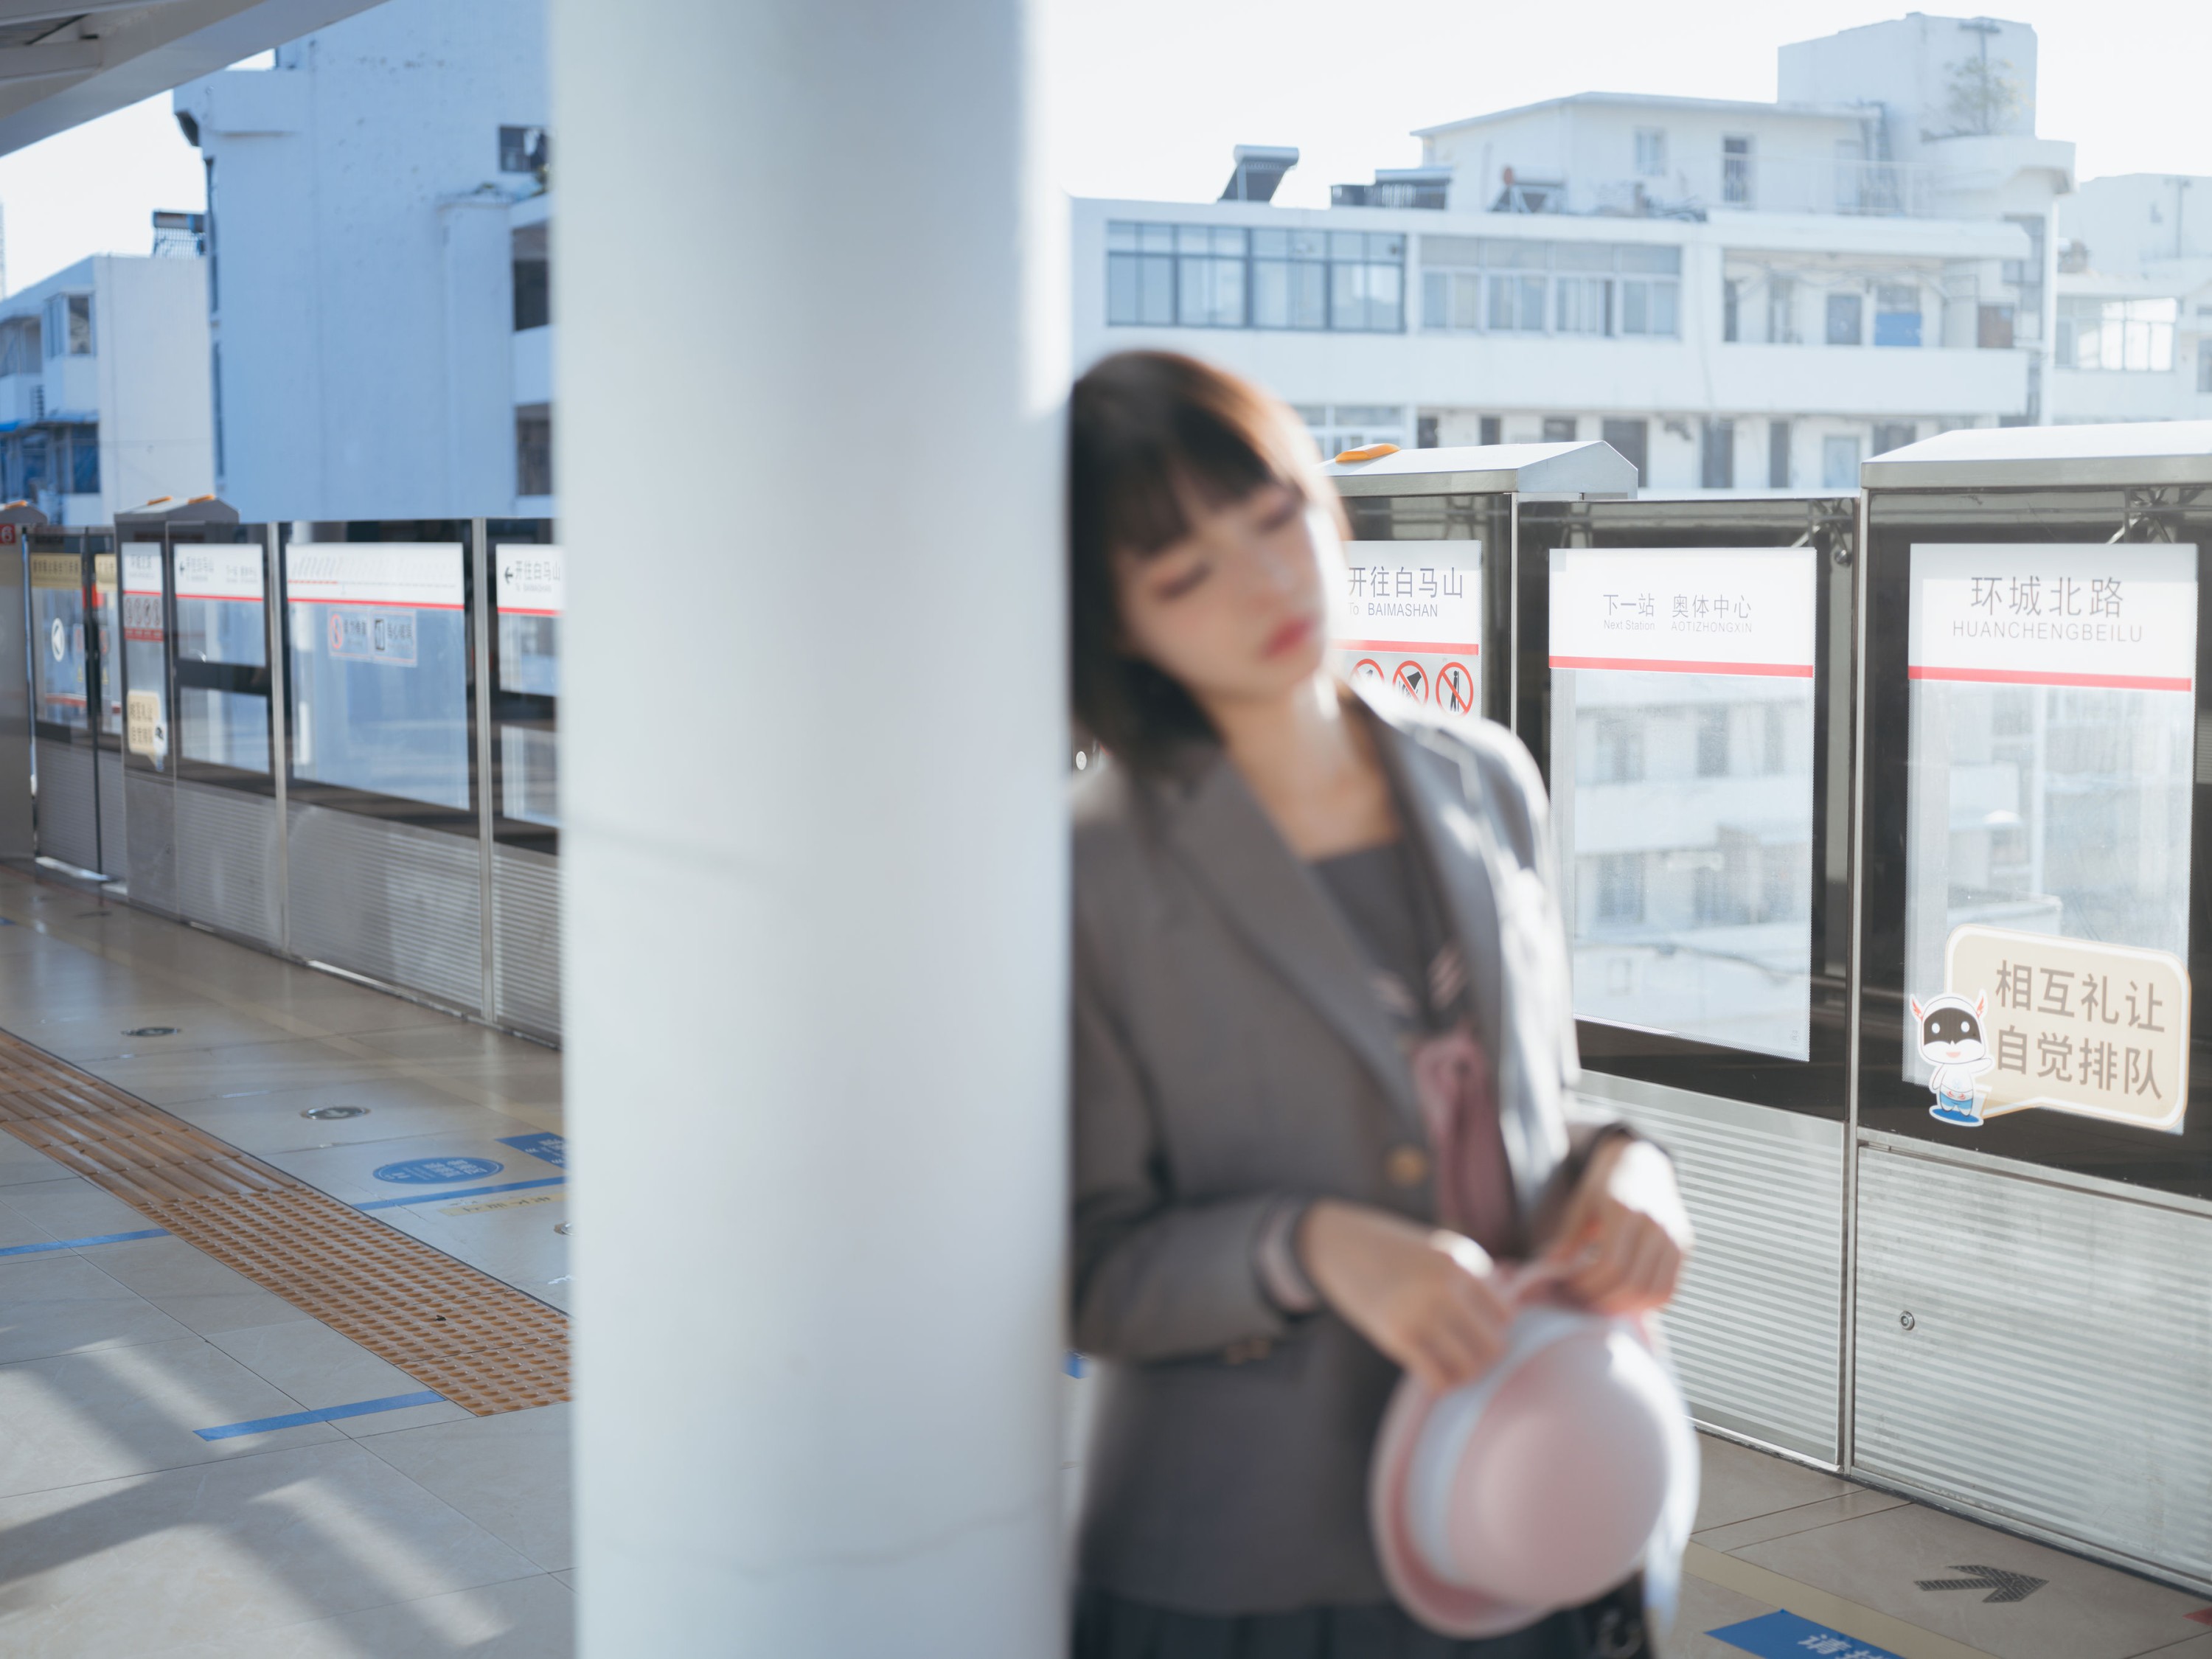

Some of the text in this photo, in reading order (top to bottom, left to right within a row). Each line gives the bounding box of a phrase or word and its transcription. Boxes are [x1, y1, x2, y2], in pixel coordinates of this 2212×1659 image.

[515, 560, 561, 581] 开往白马山
[1347, 566, 1463, 599] 开往白马山
[1367, 602, 1439, 617] BAIMASHAN
[1602, 593, 1752, 619] 下一站 奥体中心
[1971, 575, 2124, 618] 环城北路
[1604, 619, 1753, 633] Next Station AOTIZHONGXIN
[1952, 619, 2143, 643] HUANCHENGBEILU
[1995, 959, 2166, 1033] 相互礼让
[1997, 1024, 2163, 1101] 自觉排队
